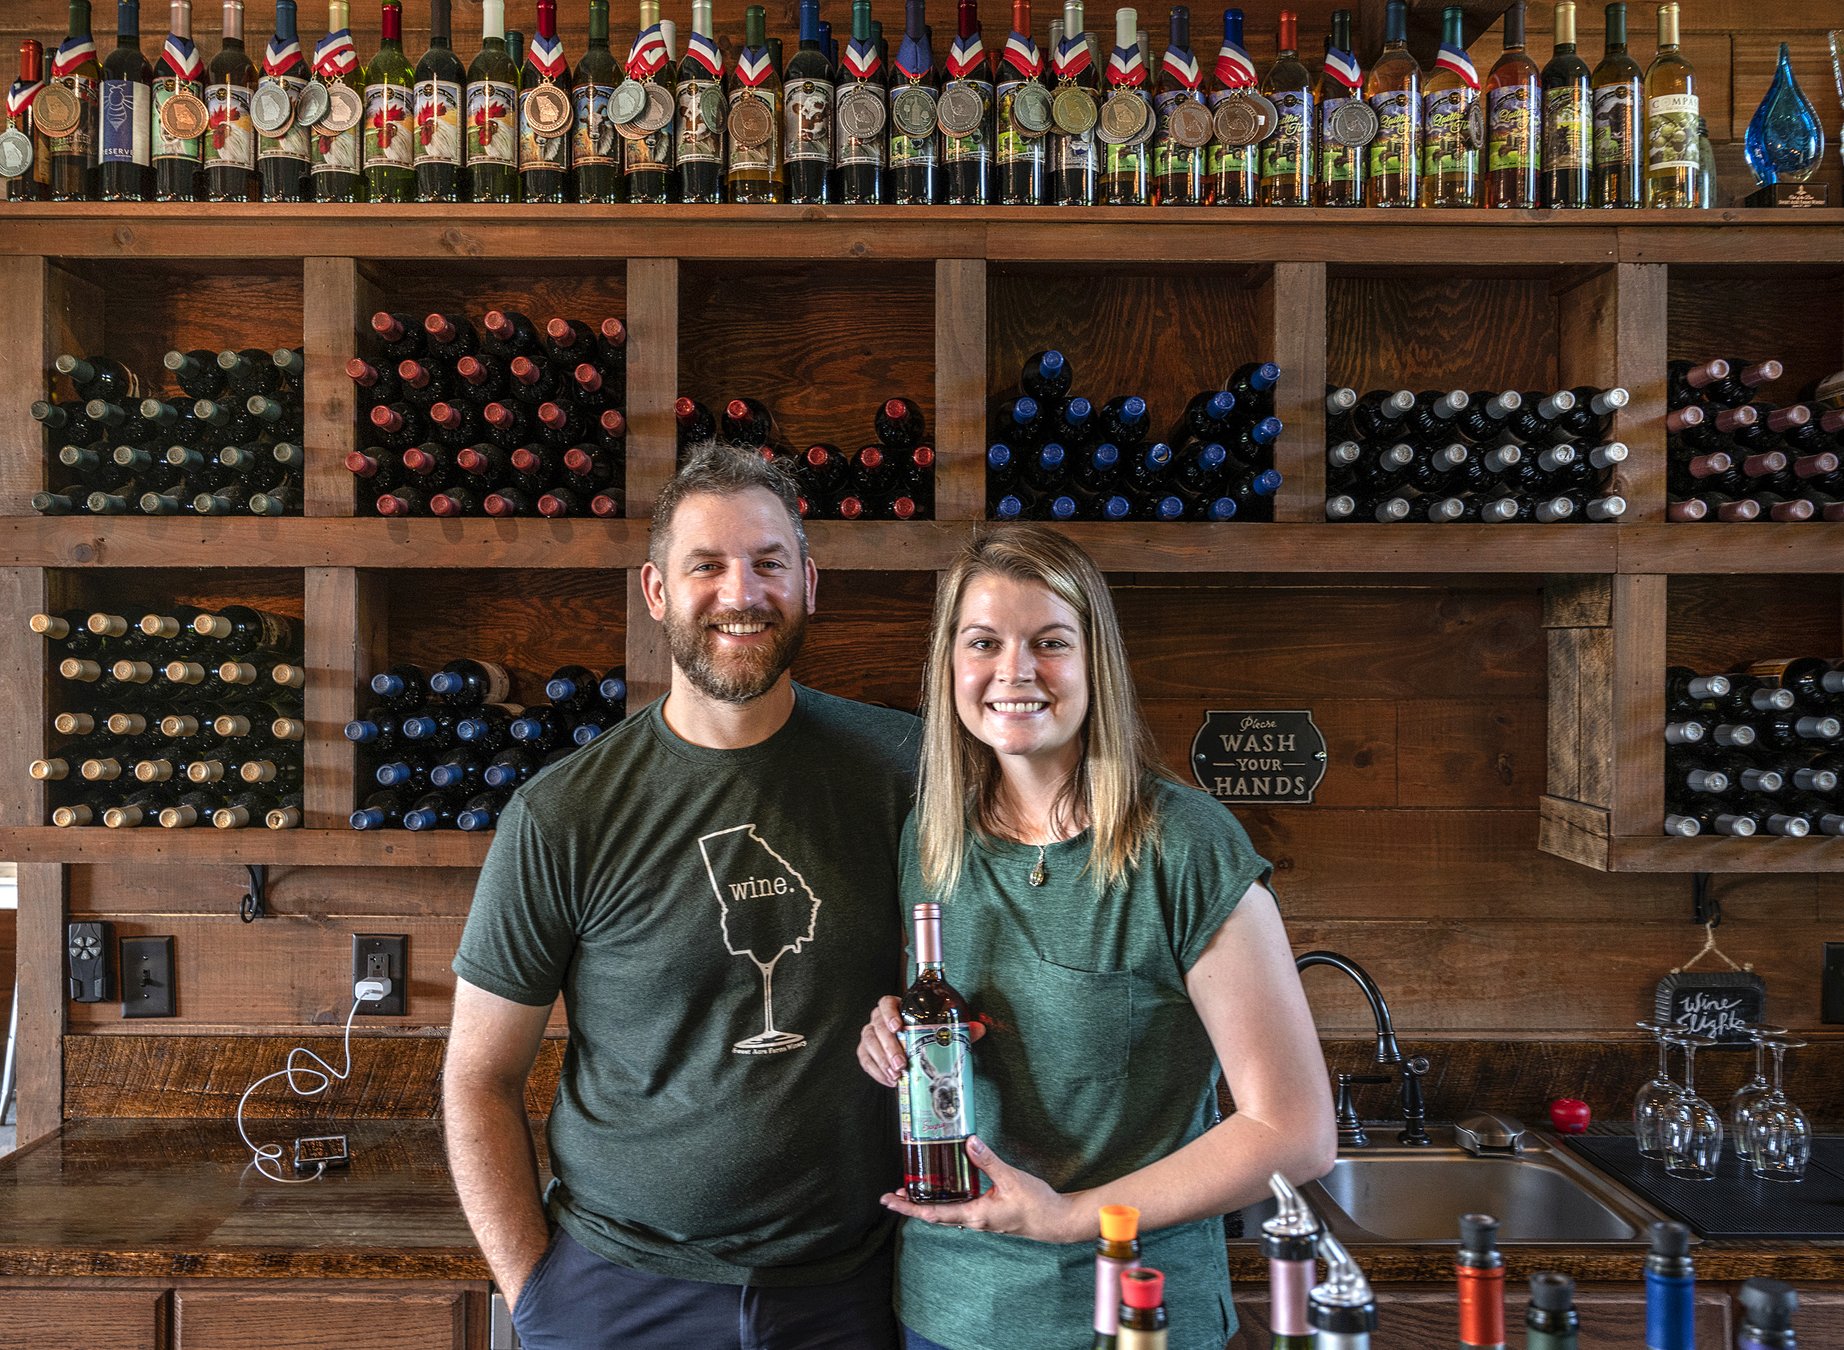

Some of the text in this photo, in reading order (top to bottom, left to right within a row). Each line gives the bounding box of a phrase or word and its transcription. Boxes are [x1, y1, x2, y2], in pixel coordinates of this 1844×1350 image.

[1239, 715, 1277, 732] Please
[1219, 734, 1295, 752] WASH
[1236, 759, 1281, 771] YOUR
[1214, 776, 1305, 796] HANDS
[728, 876, 795, 901] wine.
[1678, 992, 1743, 1013] Wine
